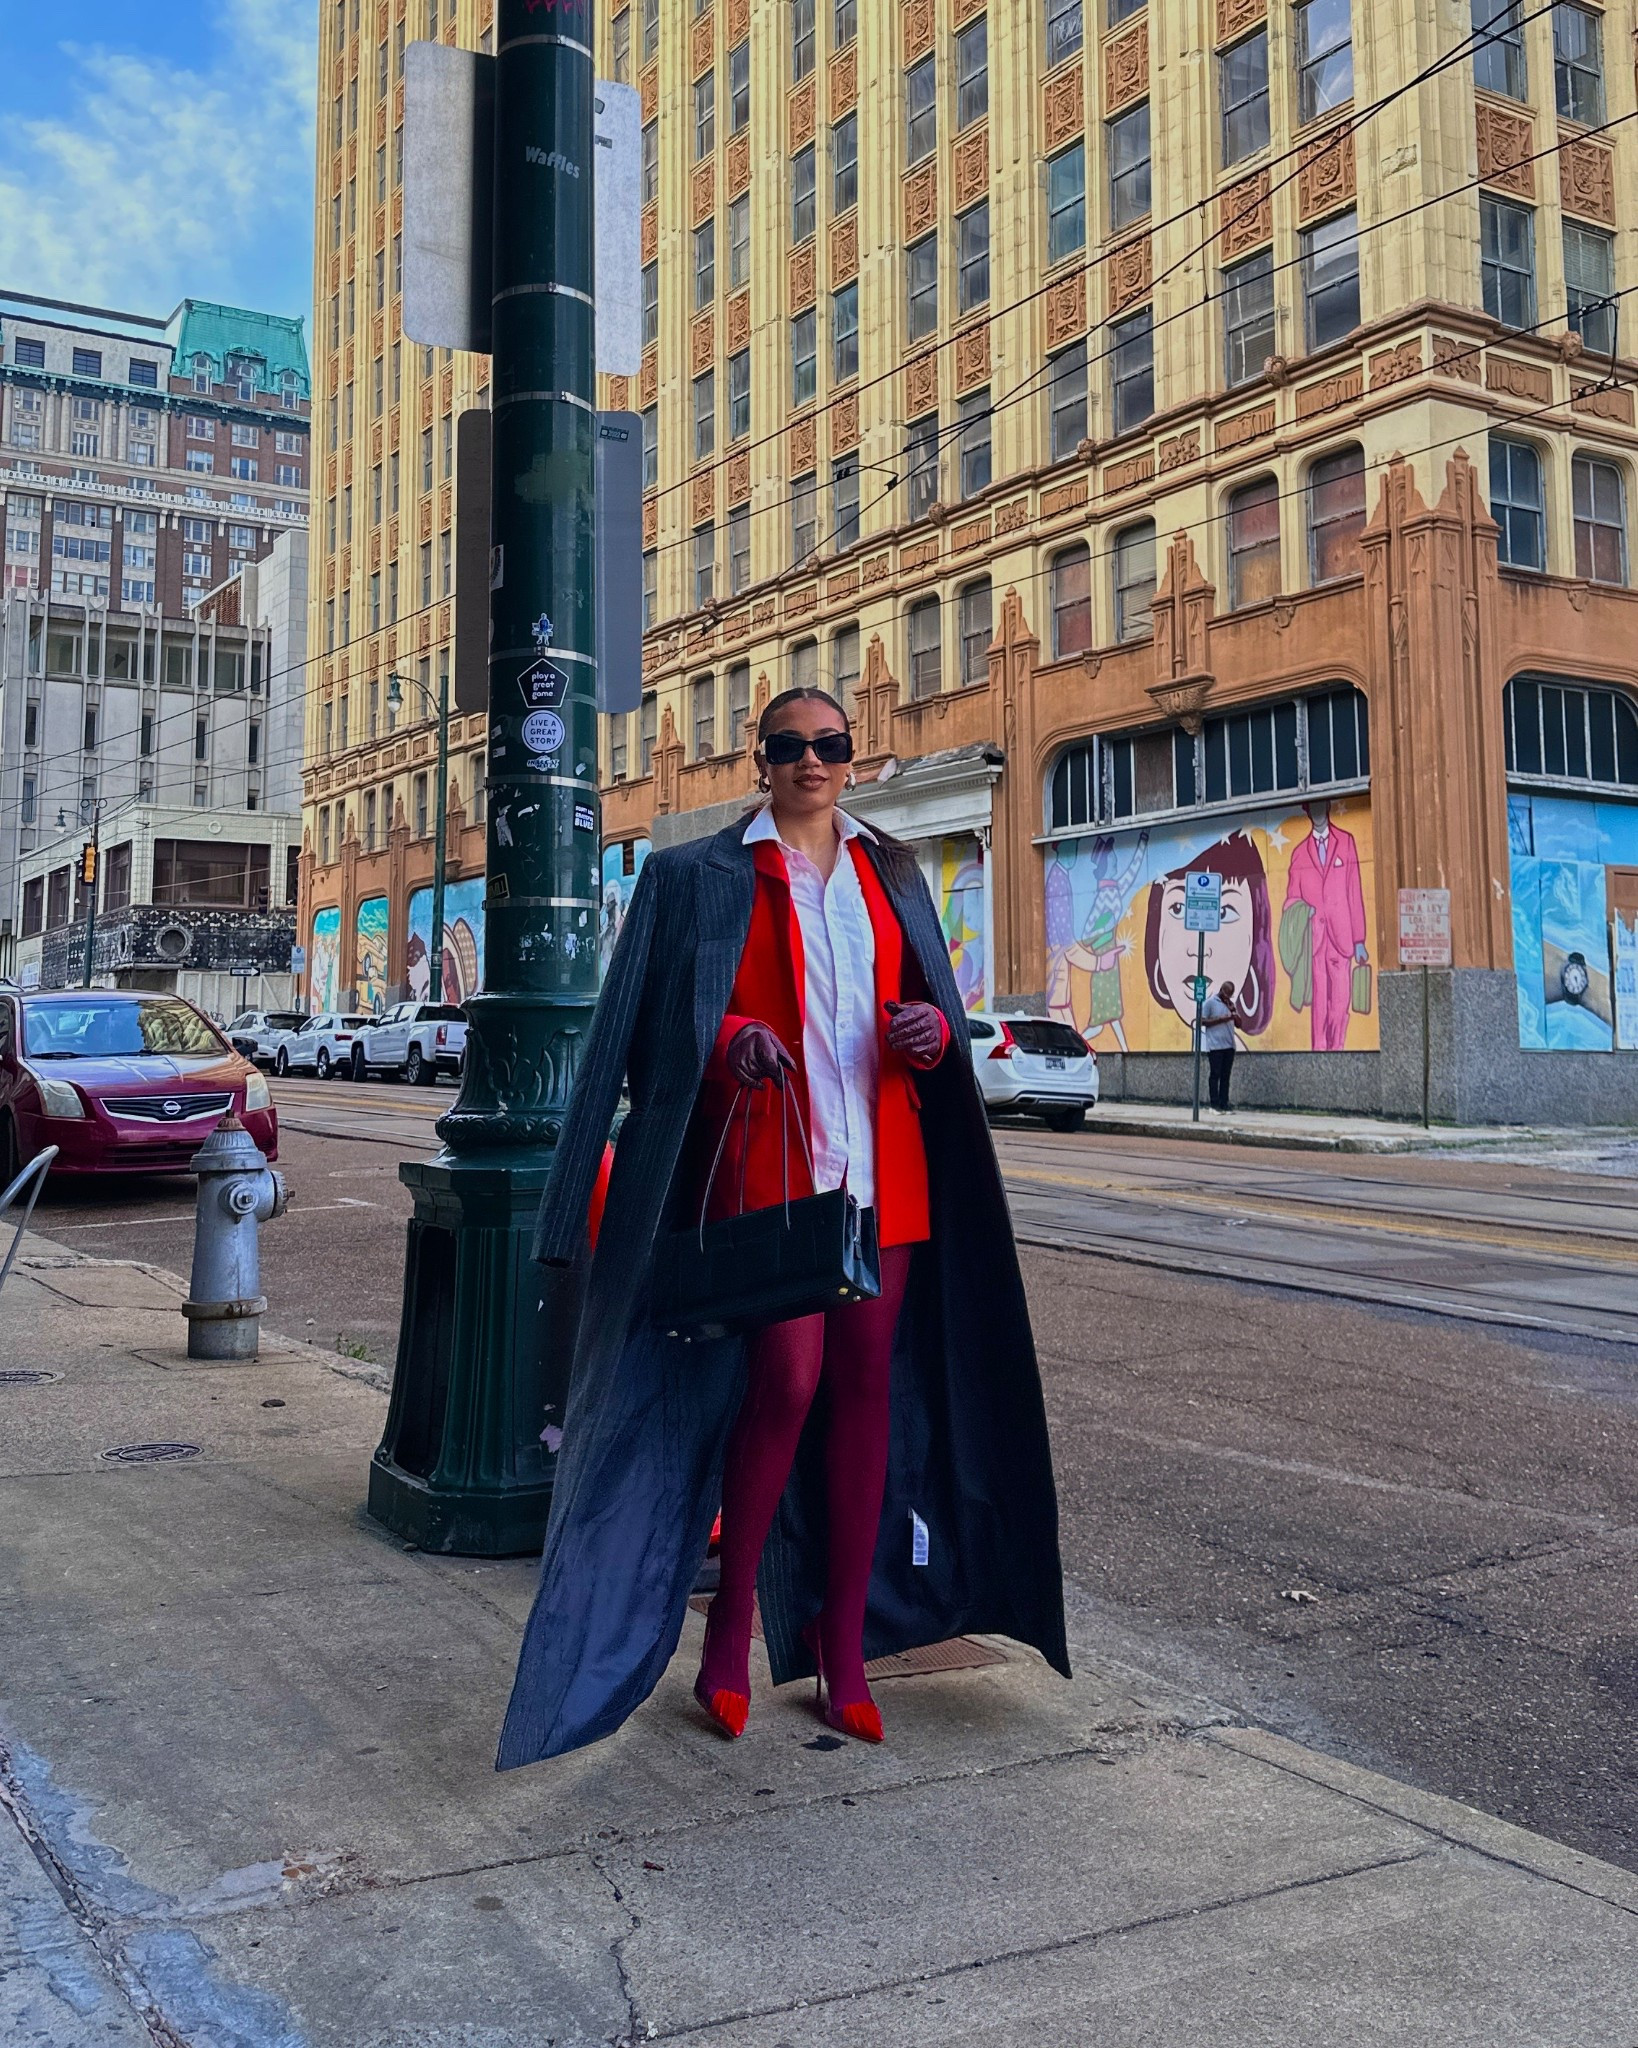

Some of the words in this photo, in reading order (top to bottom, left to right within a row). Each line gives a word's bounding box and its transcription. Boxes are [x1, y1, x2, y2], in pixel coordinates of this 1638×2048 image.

[525, 146, 580, 179] Waffles
[532, 671, 549, 682] play
[533, 682, 555, 691] great
[530, 719, 548, 727] LIVE
[530, 728, 557, 736] GREAT
[530, 737, 557, 745] STORY
